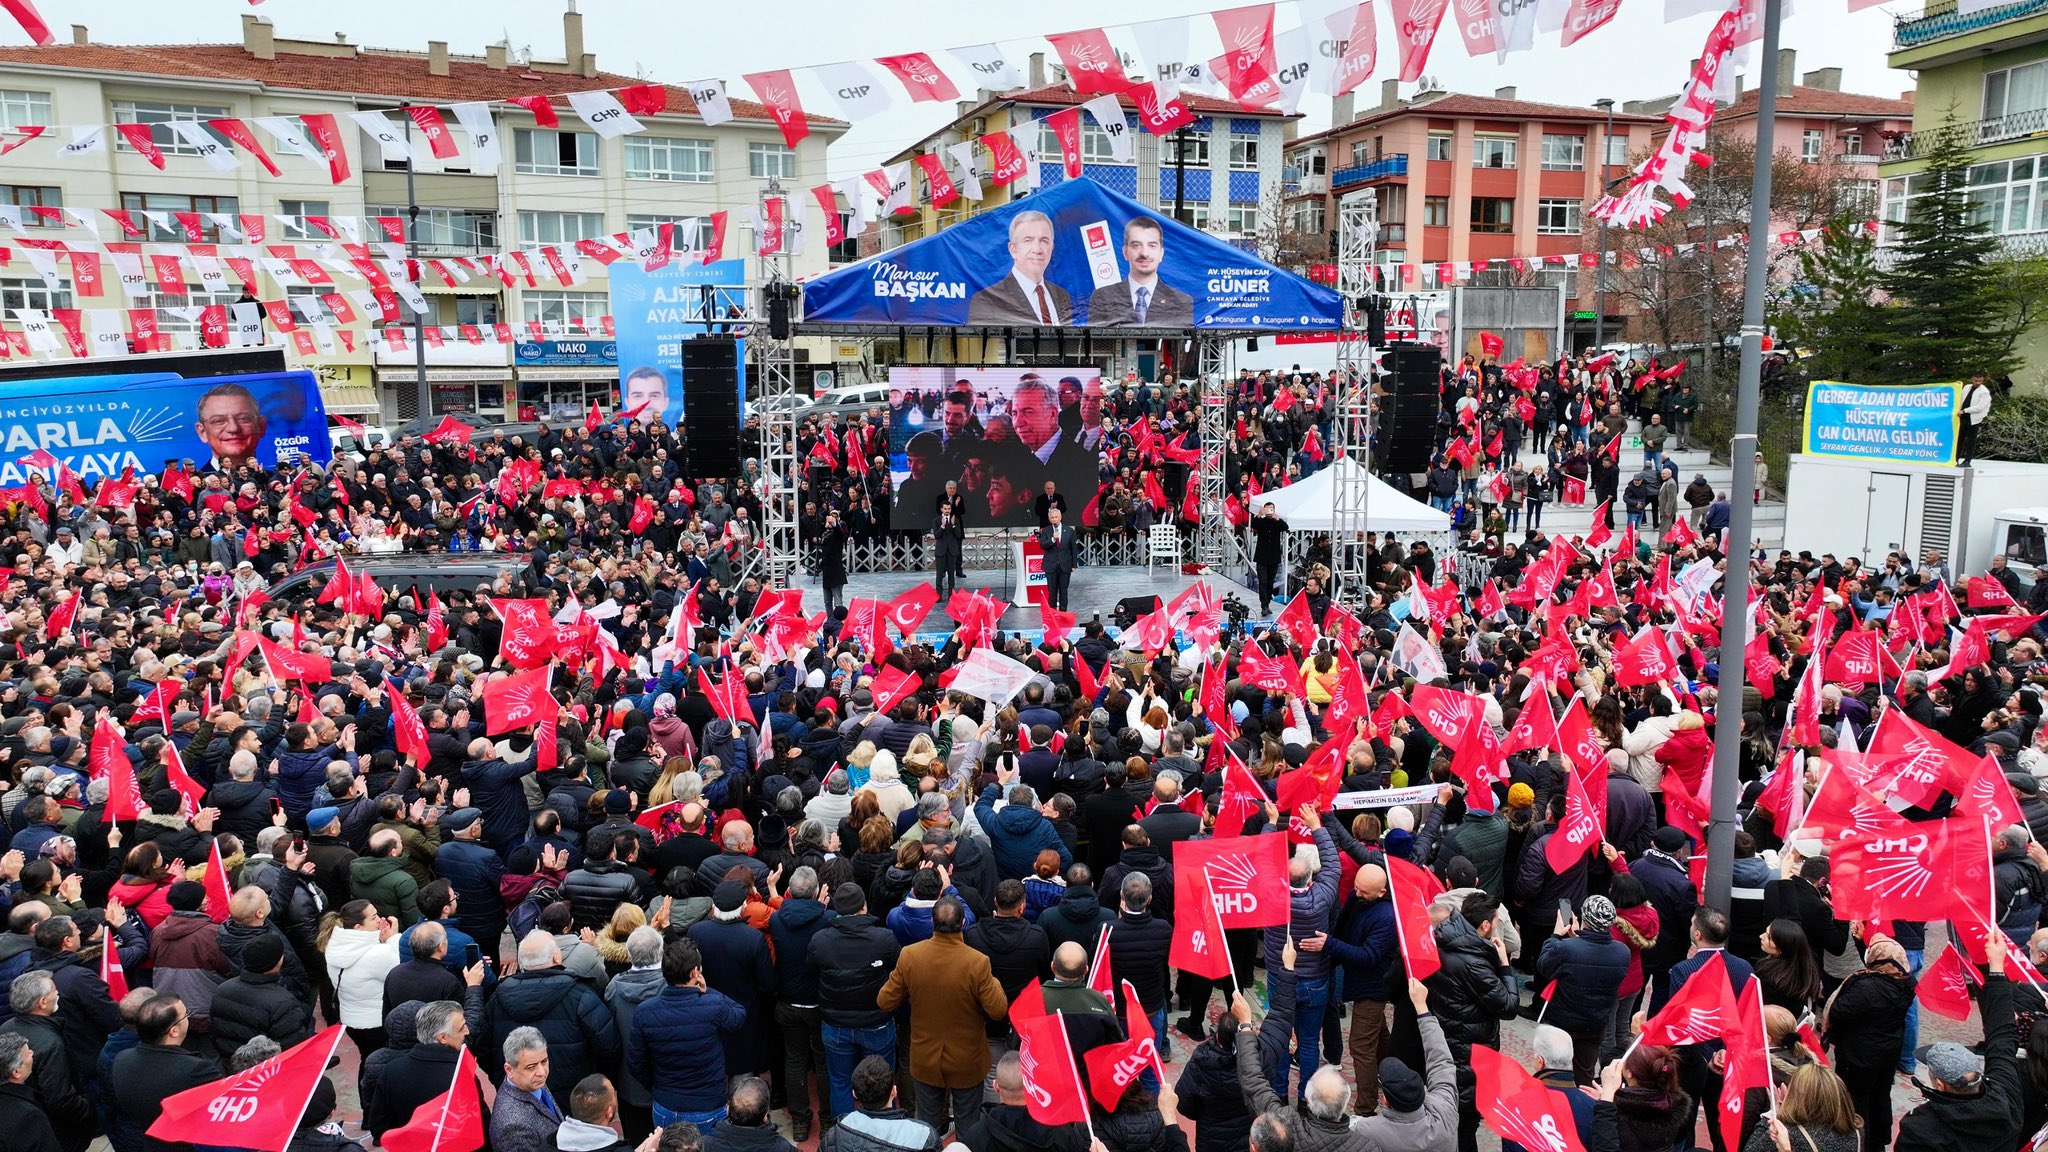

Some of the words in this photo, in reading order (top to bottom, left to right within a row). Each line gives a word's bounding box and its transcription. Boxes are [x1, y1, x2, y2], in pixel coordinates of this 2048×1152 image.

[1571, 5, 1612, 32] CHP
[1467, 18, 1497, 40] CHP
[1319, 39, 1349, 58] CHP
[1237, 45, 1266, 71] CHP
[972, 60, 1004, 74] CHP
[1078, 61, 1109, 74] CHP
[1157, 62, 1183, 81] HP
[1279, 62, 1309, 85] CHP
[1340, 54, 1371, 79] CHP
[911, 74, 939, 86] CHP
[693, 88, 717, 106] HP
[838, 85, 871, 100] CHP
[591, 109, 620, 123] CHP
[1151, 105, 1180, 127] CHP
[424, 126, 441, 140] HP
[197, 143, 217, 157] HP
[997, 158, 1023, 180] CHP
[889, 181, 906, 195] HP
[933, 185, 950, 199] HP
[78, 275, 94, 283] CHP
[122, 275, 144, 283] CHP
[203, 273, 222, 281] CHP
[275, 268, 292, 276] CHP
[868, 261, 939, 284] Mansur
[875, 281, 965, 302] BAŞKAN
[1208, 276, 1269, 293] GÜNER
[208, 325, 223, 334] CHP
[242, 325, 259, 333] CHP
[98, 333, 121, 342] CHP
[557, 343, 587, 353] NAKO
[1817, 390, 1895, 406] KERBELADAN
[1897, 390, 1949, 408] BUGÜNE
[1846, 408, 1909, 426] HÜSEYİN'E
[274, 436, 309, 447] ÖZGÜR
[1818, 426, 1839, 440] CAN
[1842, 427, 1888, 443] OLMAYA
[1892, 428, 1942, 446] GELDİK.
[276, 447, 301, 455] ÖZEL
[1821, 442, 1846, 451] SEYRAN
[1889, 448, 1913, 456] SEDAR
[557, 630, 579, 643] CHP
[506, 640, 530, 660] CHP
[1864, 834, 1928, 853] CHP
